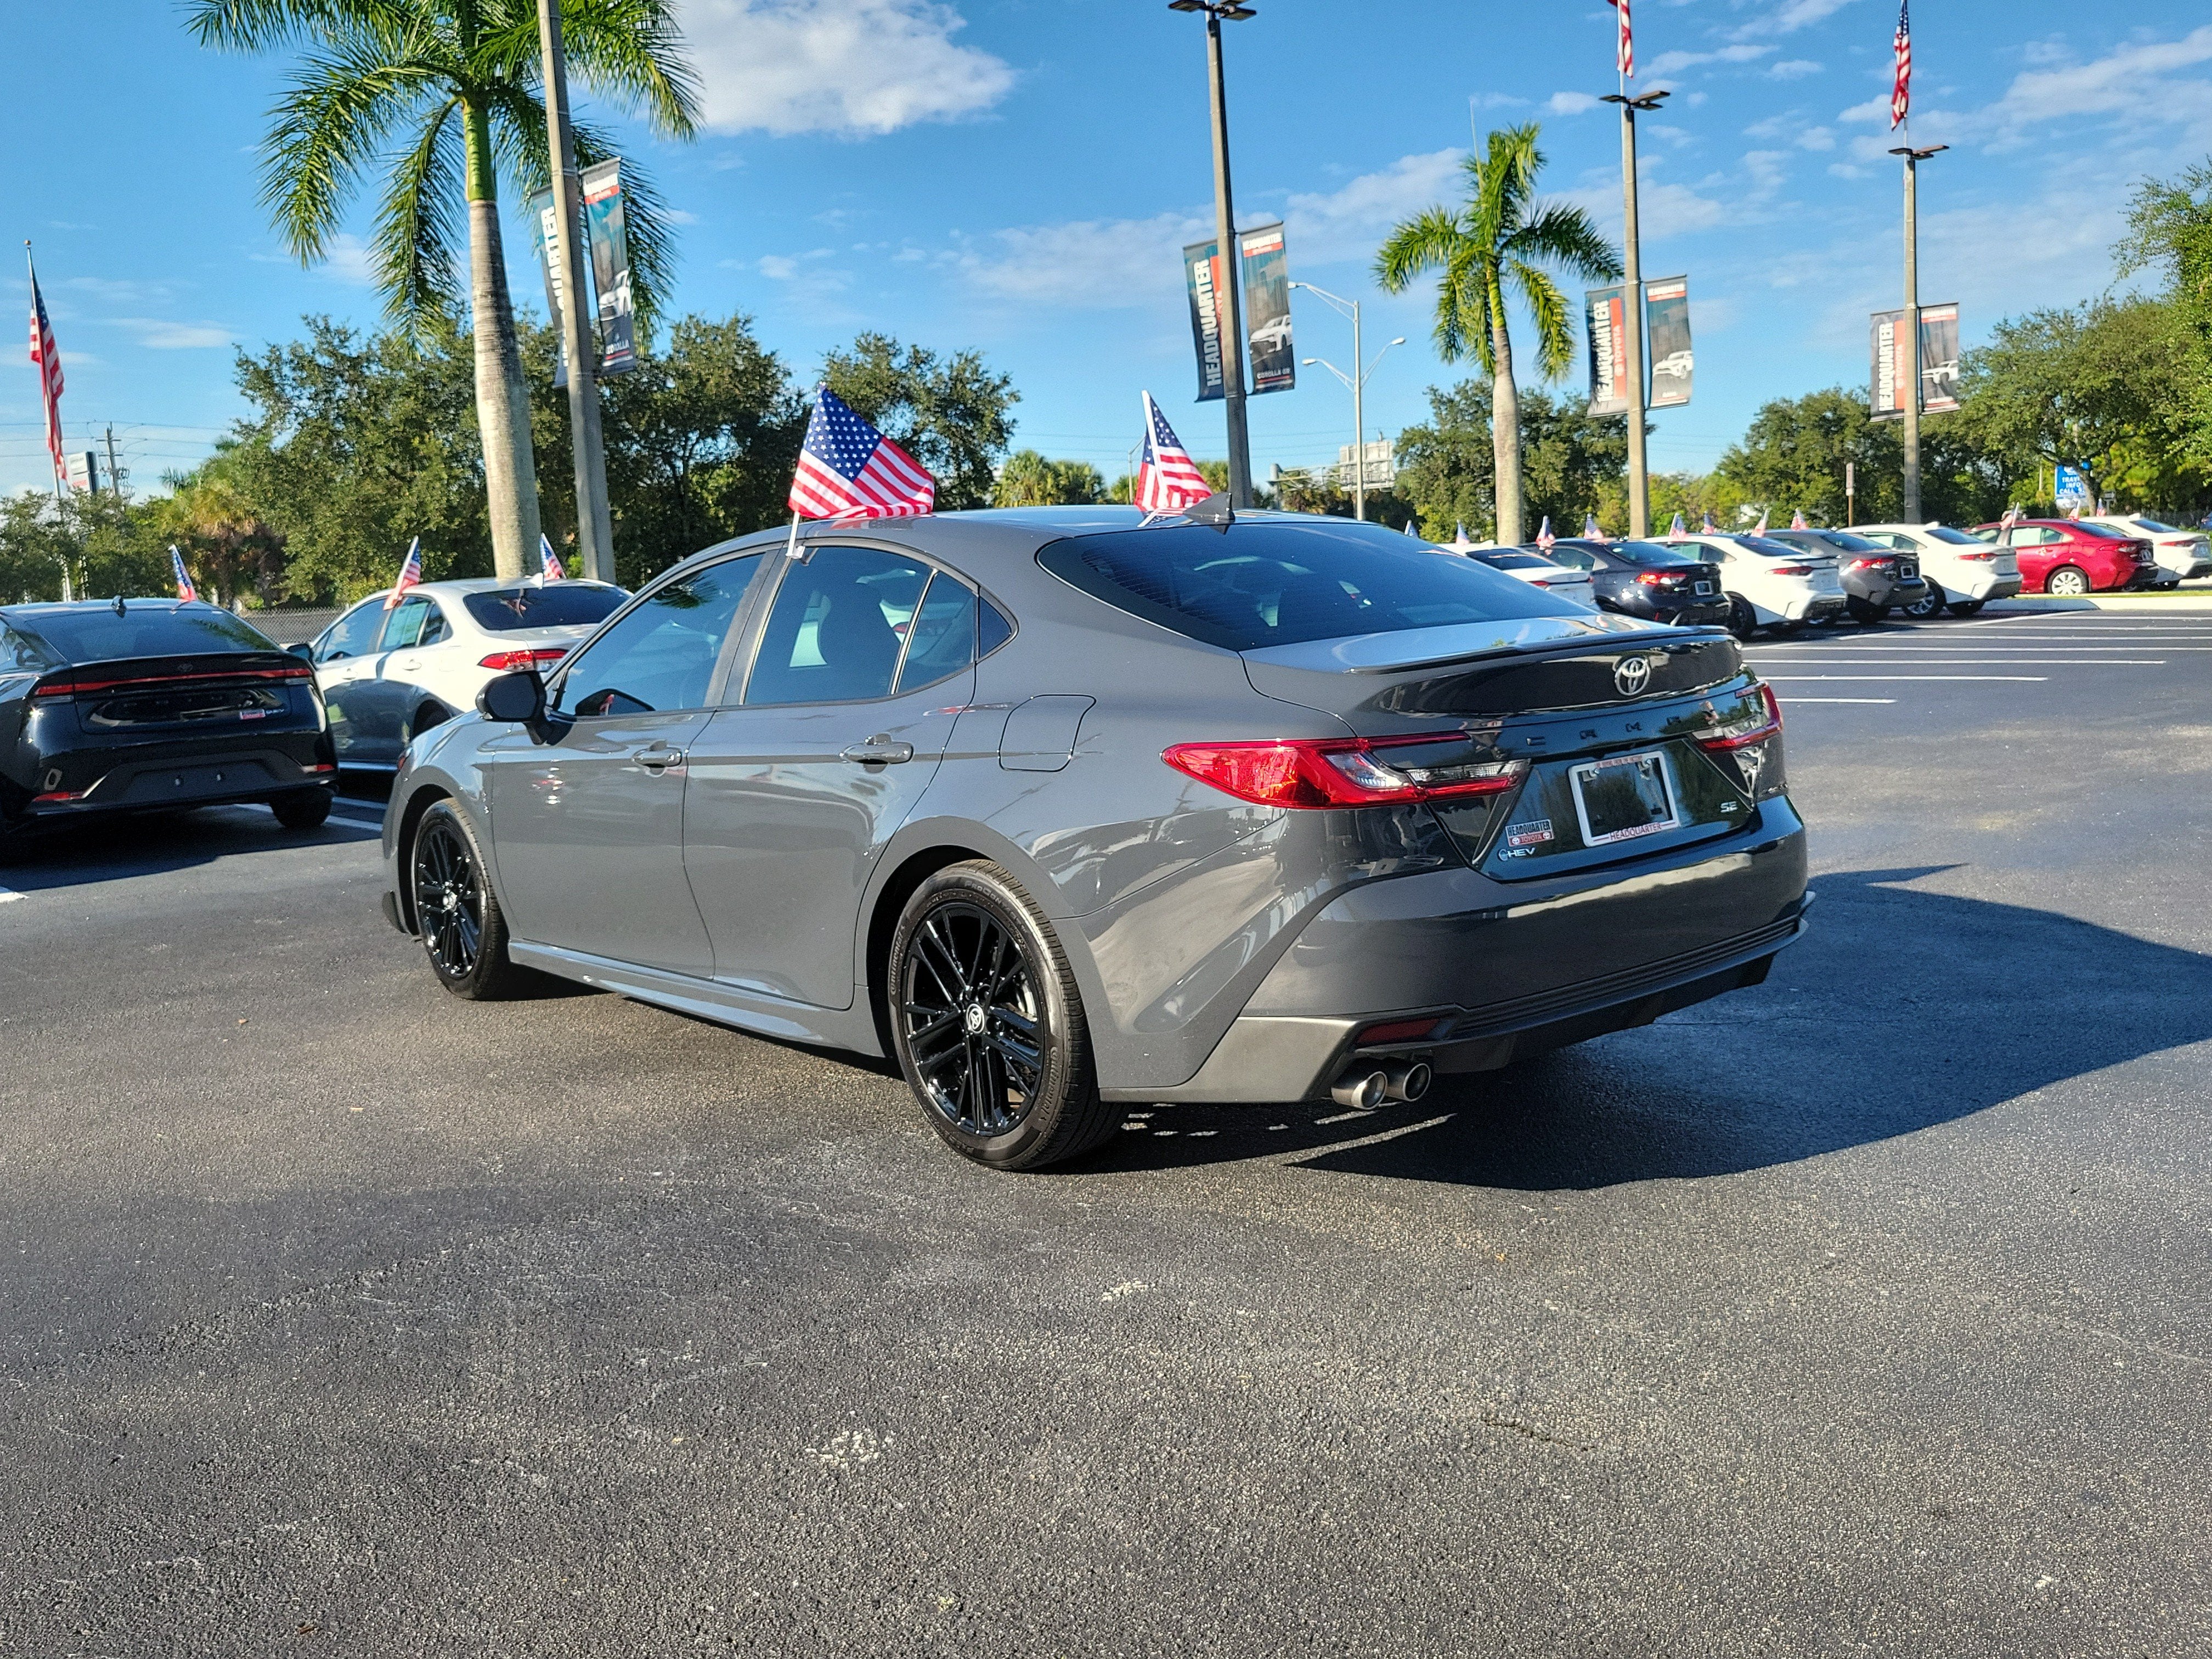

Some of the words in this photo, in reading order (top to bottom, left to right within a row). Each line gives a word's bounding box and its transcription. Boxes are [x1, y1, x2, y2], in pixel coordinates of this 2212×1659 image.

[1194, 258, 1222, 387] HEADQUARTER
[1878, 322, 1895, 411] HEADQUARTER
[1720, 801, 1738, 813] SE
[1507, 821, 1551, 837] HEADQUARTER
[1611, 823, 1662, 840] HEADQUARTER
[1521, 833, 1543, 843] TOYOTA
